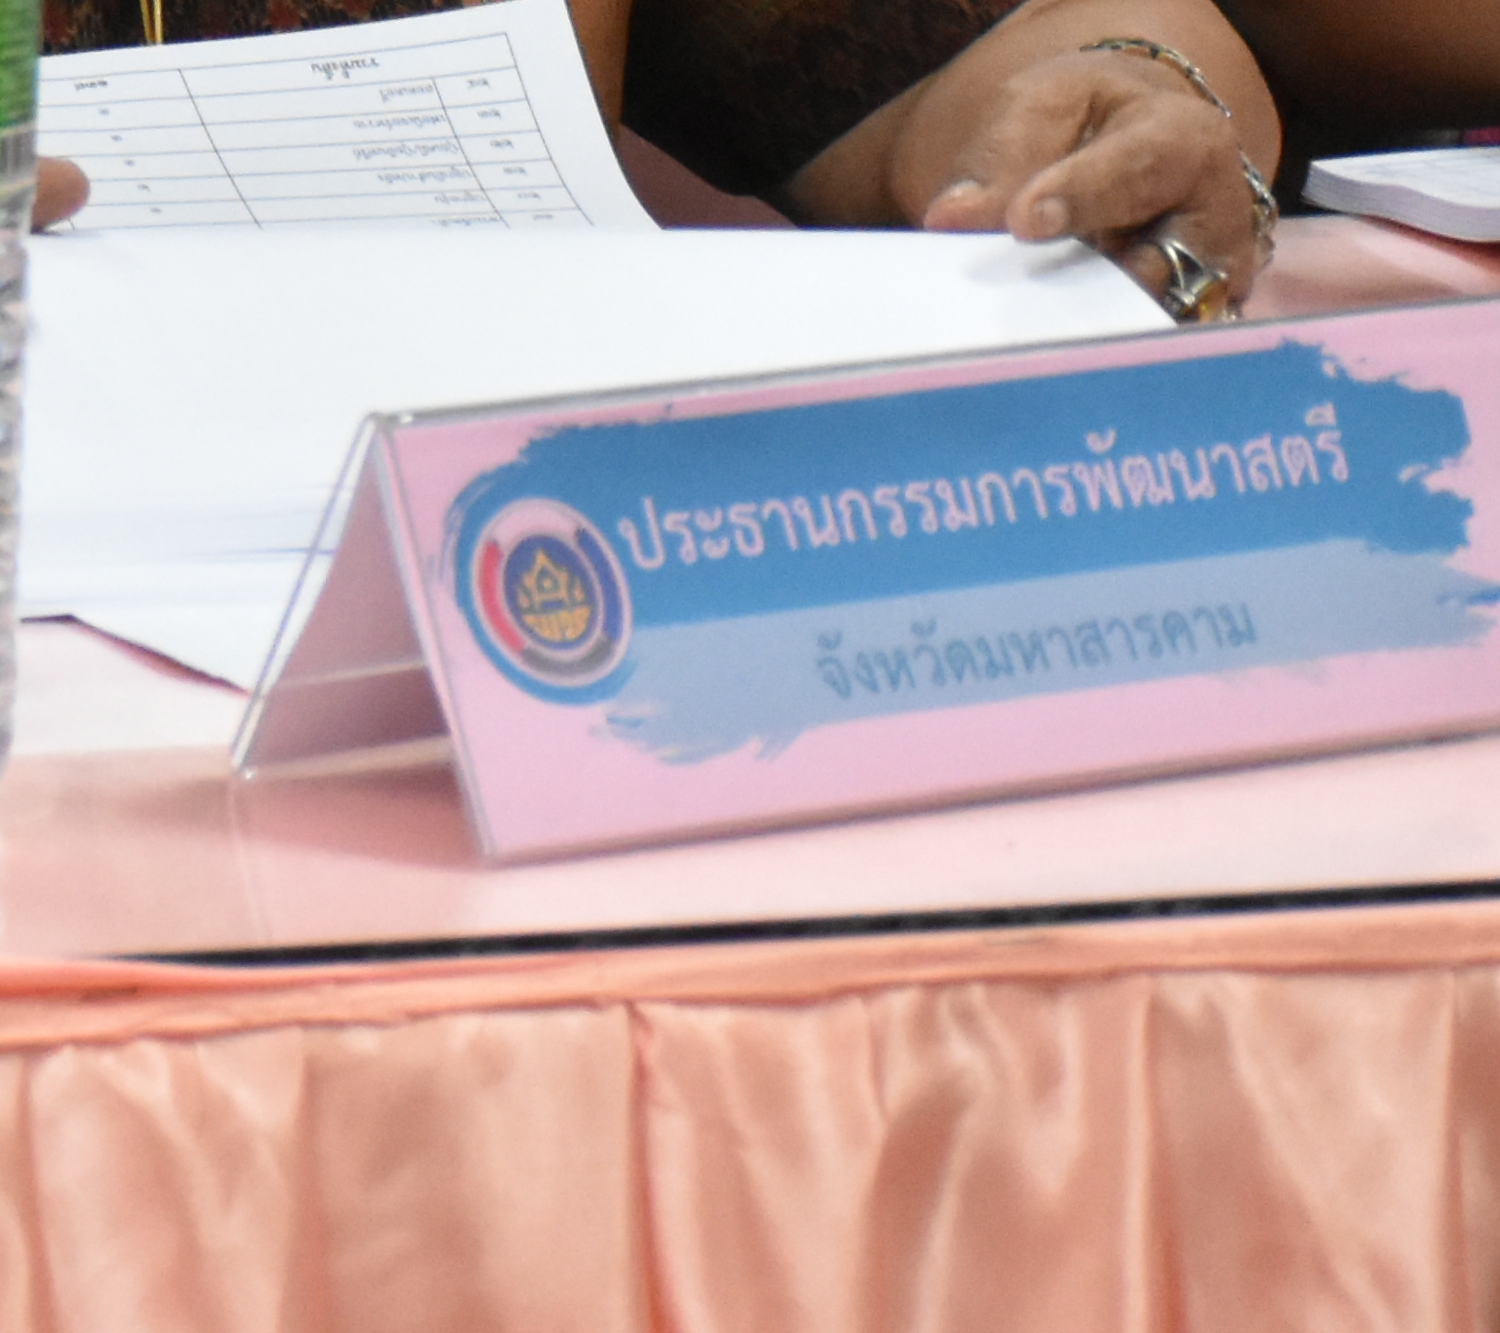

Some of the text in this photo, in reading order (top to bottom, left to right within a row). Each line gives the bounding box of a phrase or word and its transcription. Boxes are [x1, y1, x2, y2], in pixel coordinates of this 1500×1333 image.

[615, 401, 1352, 574] ประธานกรรมการพัฒนาสตรี
[813, 591, 1260, 703] จังหวัดมหาสารคาม
